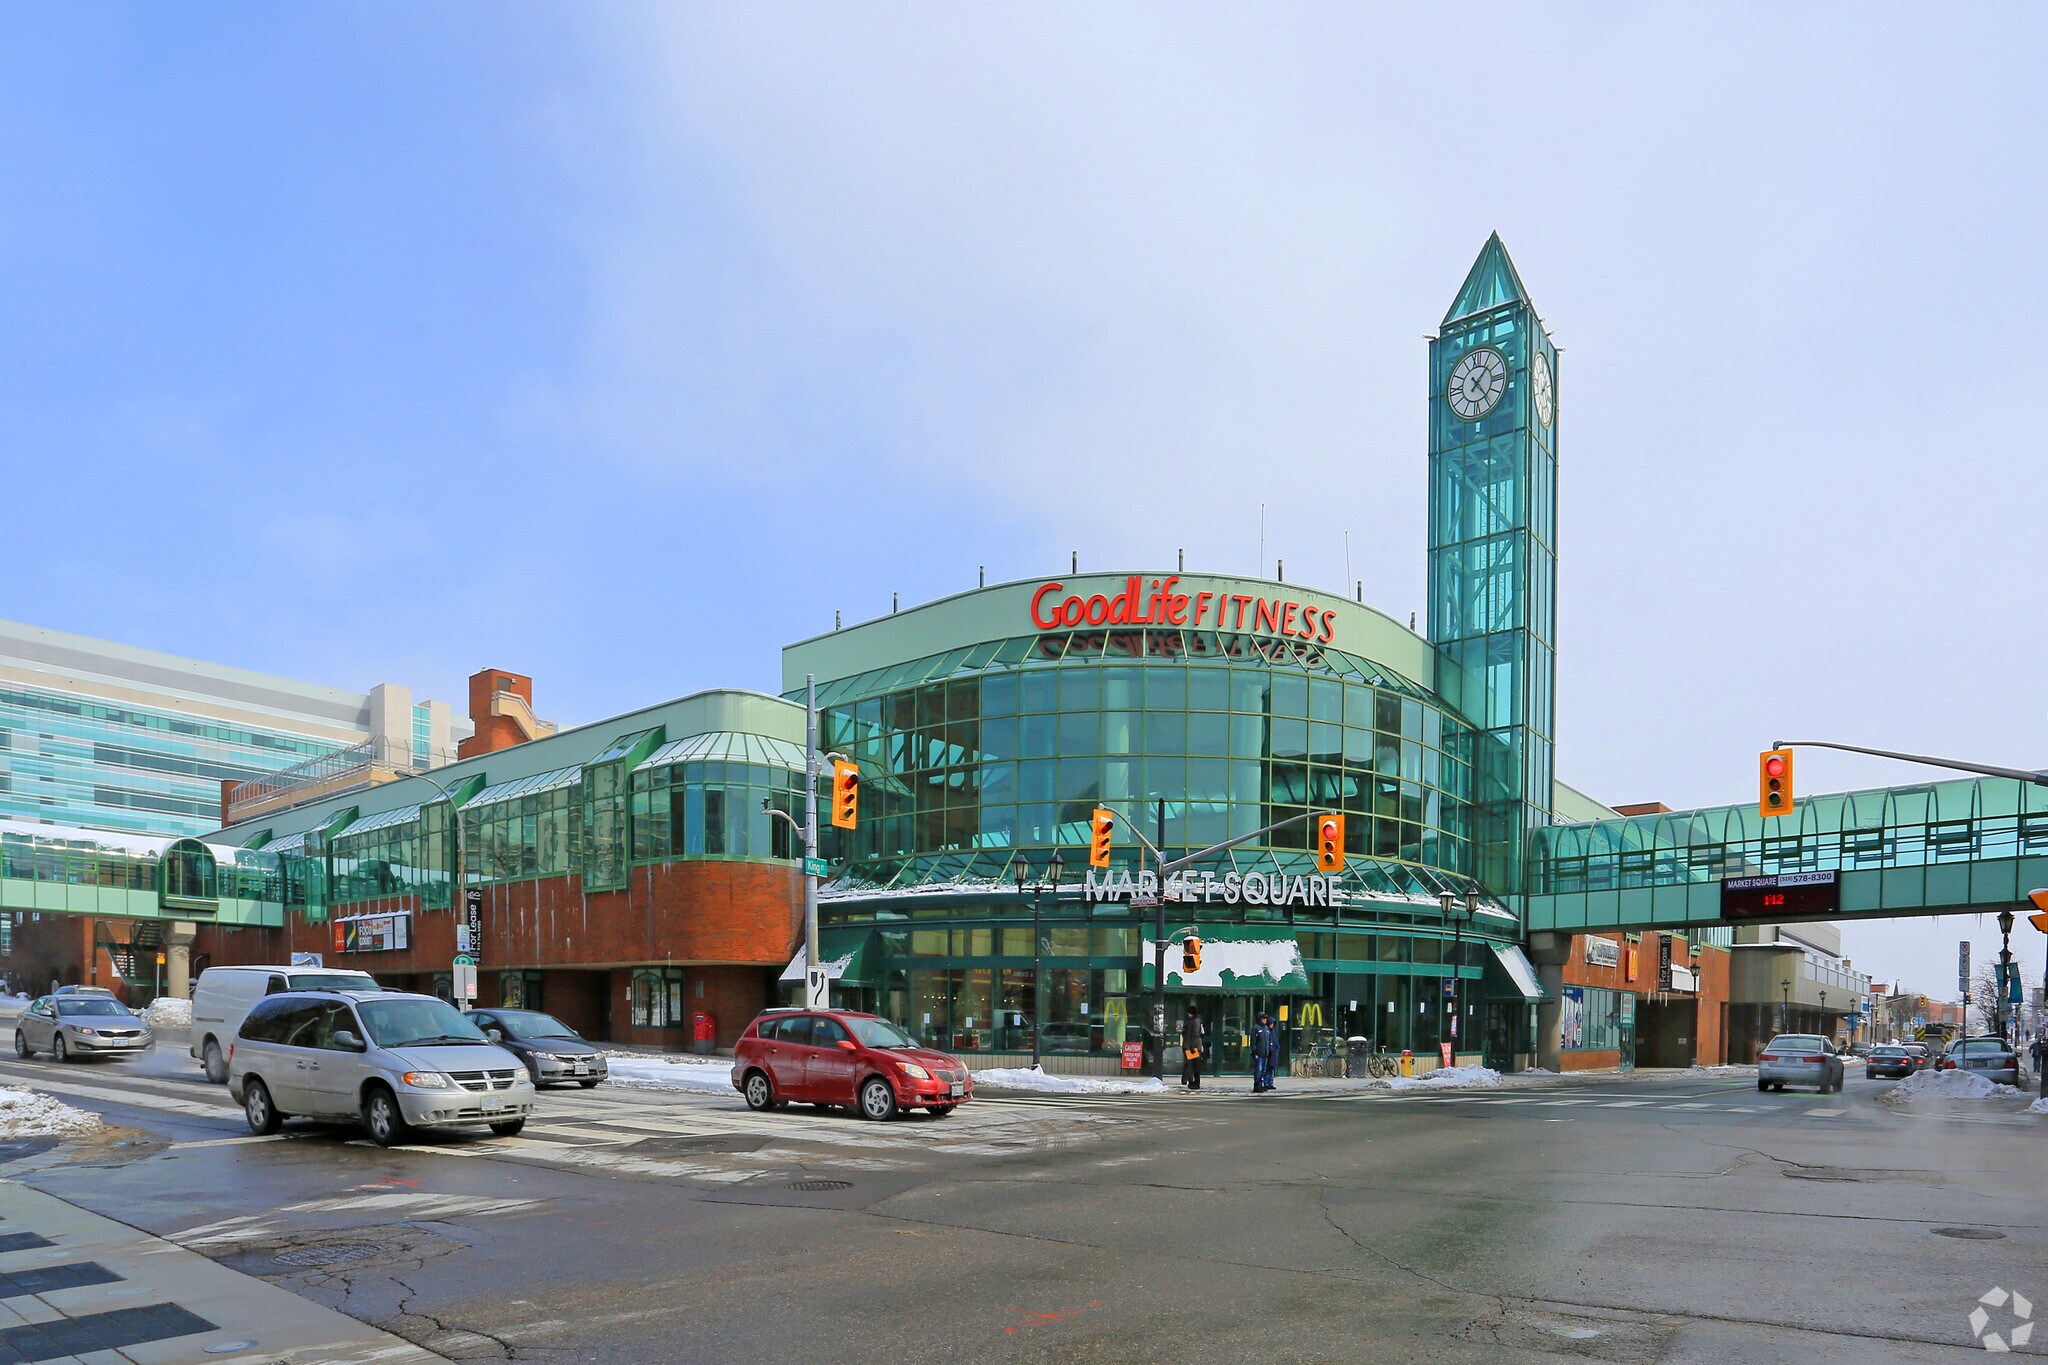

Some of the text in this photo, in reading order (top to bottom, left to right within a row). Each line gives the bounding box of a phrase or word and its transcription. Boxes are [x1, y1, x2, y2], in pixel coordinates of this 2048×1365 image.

[1030, 576, 1338, 643] GoodLife FITNESS
[807, 860, 820, 874] King
[1728, 880, 1752, 888] MARKET
[1752, 877, 1777, 886] SQUARE
[1794, 872, 1832, 882] 578-8300
[1223, 871, 1344, 908] SQUARE
[1764, 894, 1785, 906] 1:12
[359, 926, 372, 936] FOOD
